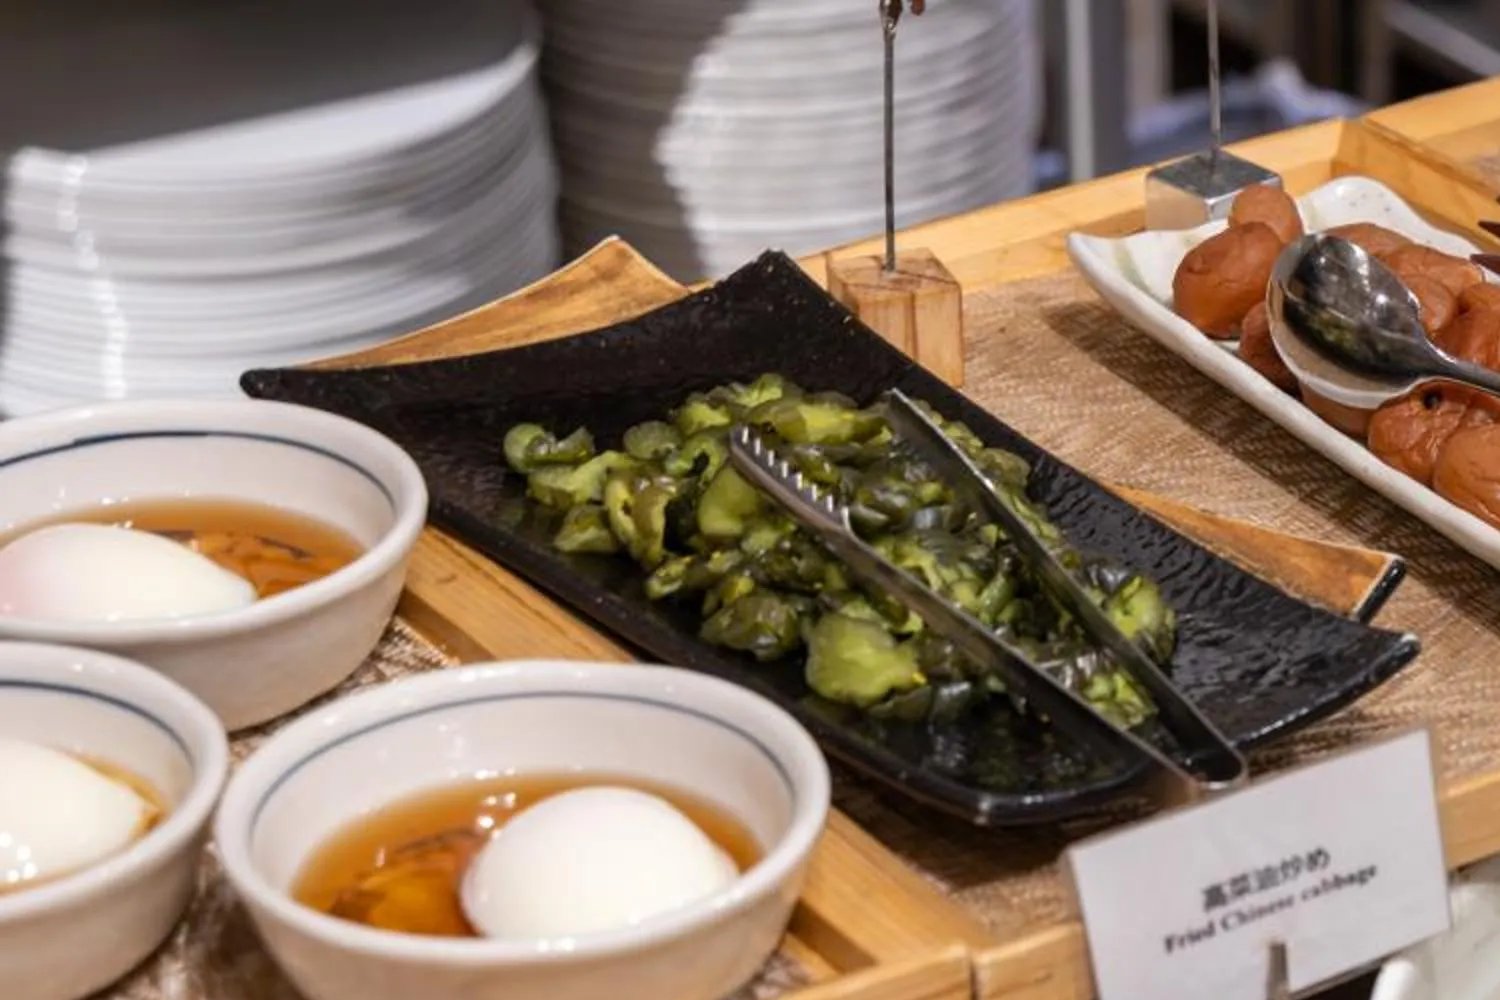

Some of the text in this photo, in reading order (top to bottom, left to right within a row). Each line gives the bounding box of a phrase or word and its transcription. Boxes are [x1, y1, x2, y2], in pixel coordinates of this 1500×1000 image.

[1164, 864, 1377, 954] Fried Chinese cabbage
